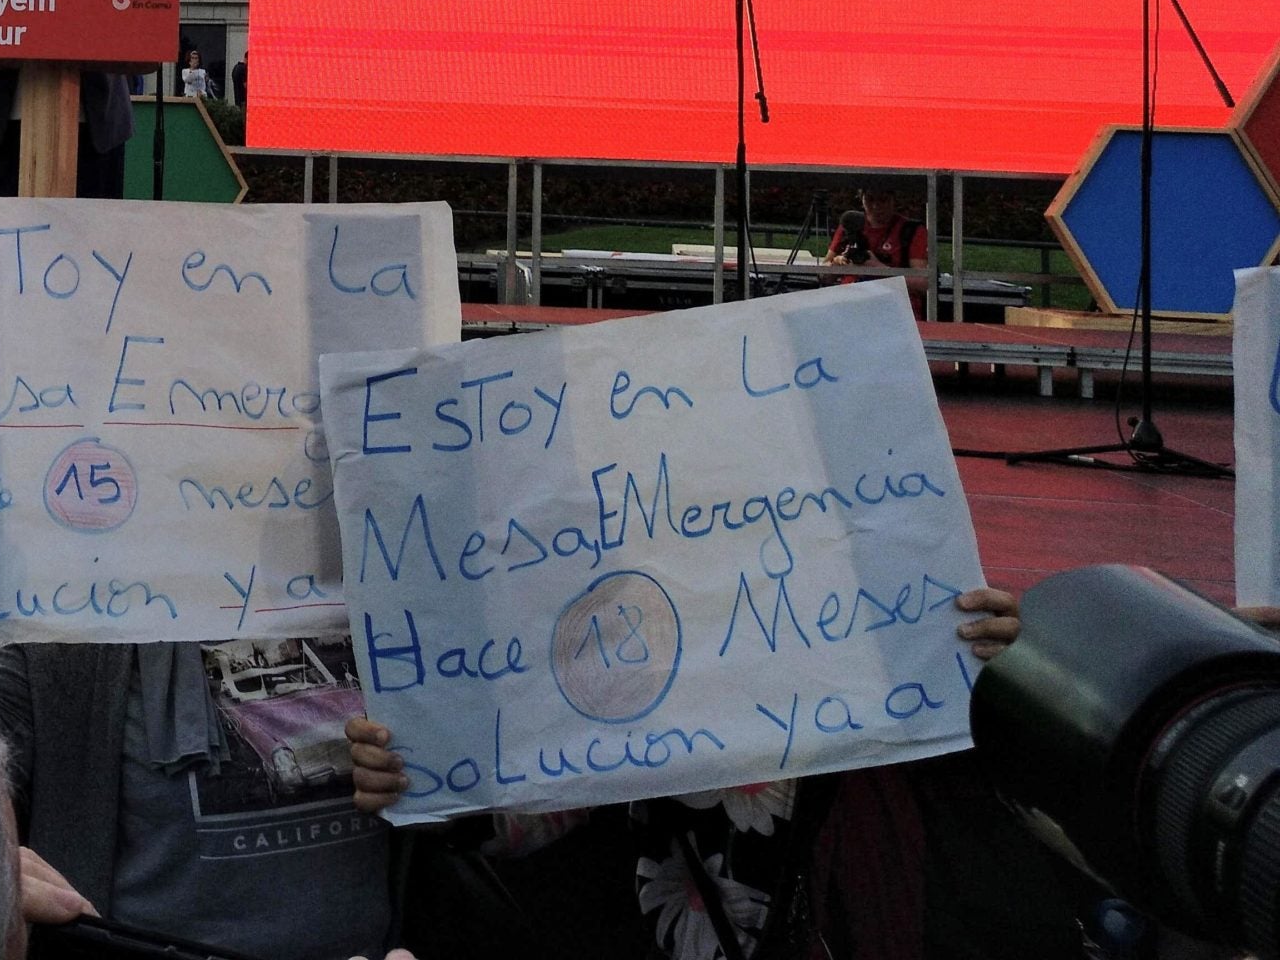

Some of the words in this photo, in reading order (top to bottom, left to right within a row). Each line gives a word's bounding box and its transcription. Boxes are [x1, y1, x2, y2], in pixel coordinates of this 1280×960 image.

[181, 250, 273, 296] en
[609, 370, 694, 420] en
[54, 462, 121, 505] 15
[364, 608, 527, 694] Hace
[573, 604, 649, 670] 18
[720, 571, 963, 657] Meses
